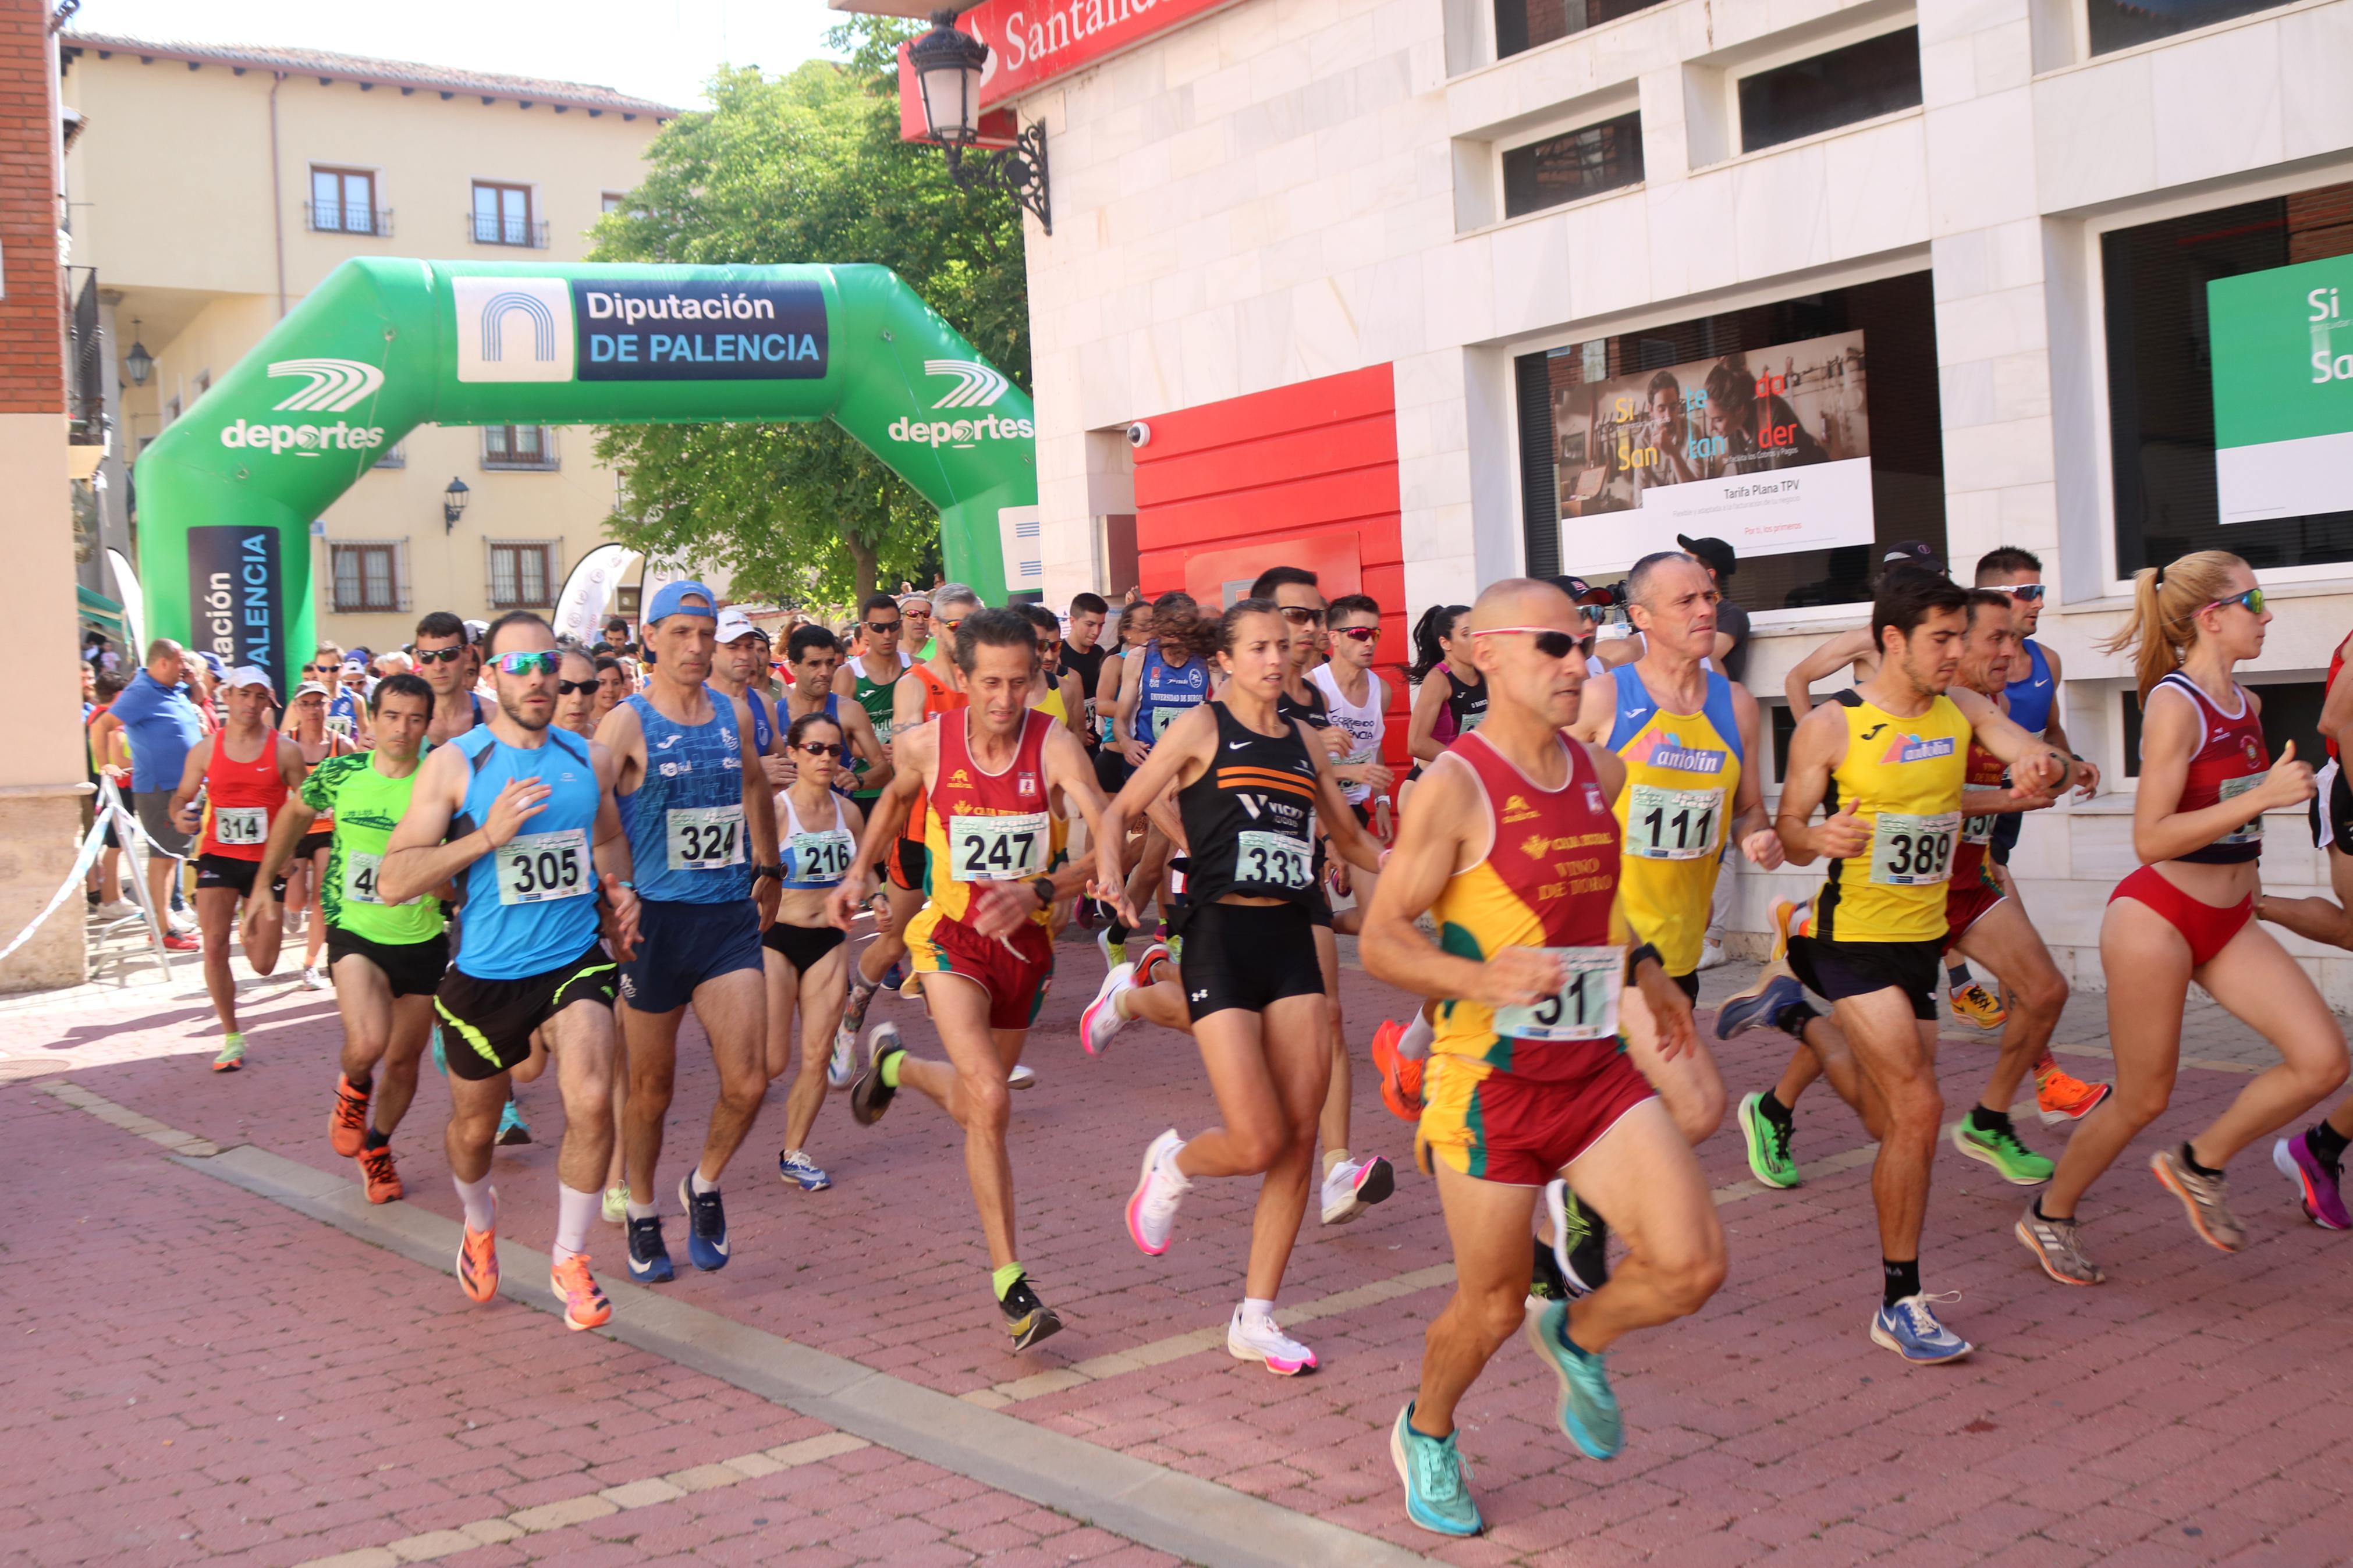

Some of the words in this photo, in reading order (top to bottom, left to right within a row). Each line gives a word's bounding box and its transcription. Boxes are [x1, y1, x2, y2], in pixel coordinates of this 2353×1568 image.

[1005, 0, 1170, 70] Santan
[587, 292, 775, 325] Diputación
[2308, 287, 2340, 322] Si
[591, 335, 639, 362] DE
[650, 334, 820, 362] PALENCIA
[1615, 397, 1634, 424] Si
[1686, 386, 1708, 411] te
[1755, 371, 1786, 399] da
[221, 418, 385, 456] deportes
[888, 414, 1035, 449] deportes
[1617, 446, 1658, 471] San
[1688, 435, 1726, 459] tan
[1758, 422, 1797, 449] der
[1724, 487, 1750, 499] Tarifa
[1752, 484, 1779, 495] Plana
[1780, 479, 1800, 492] TPV
[242, 534, 271, 670] ALENCIA
[1180, 694, 1187, 702] DE
[1658, 749, 1719, 772] antolin
[221, 817, 259, 838] 314
[681, 822, 736, 861] 324
[1644, 807, 1712, 848] 111
[512, 848, 578, 893] 305
[805, 843, 850, 874] 216
[964, 832, 1035, 871] 247
[1247, 847, 1305, 887] 333
[1888, 833, 1951, 874] 389
